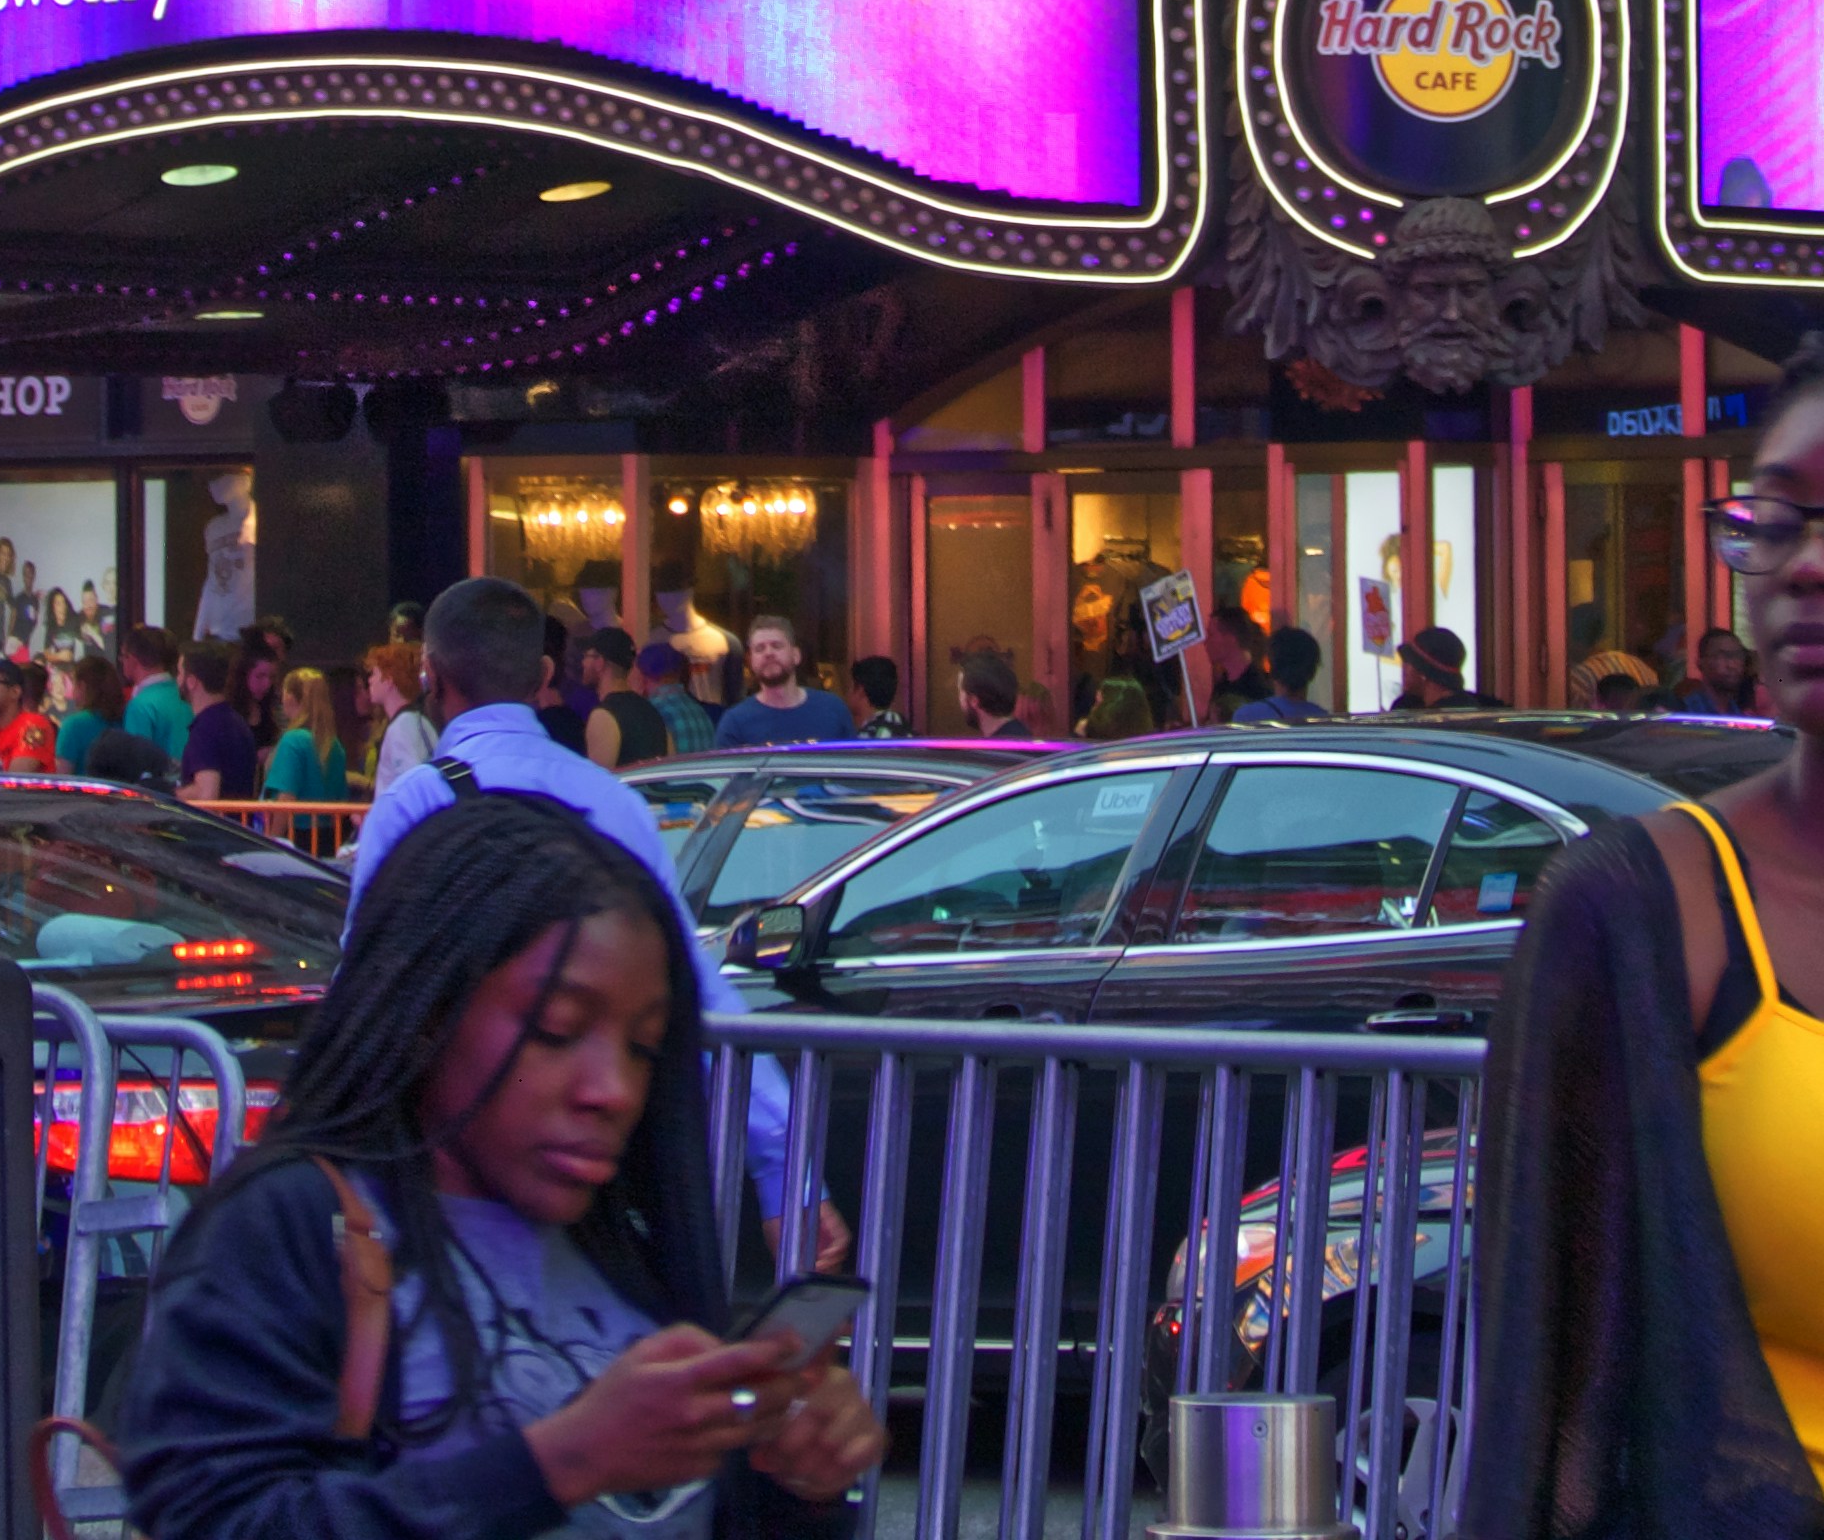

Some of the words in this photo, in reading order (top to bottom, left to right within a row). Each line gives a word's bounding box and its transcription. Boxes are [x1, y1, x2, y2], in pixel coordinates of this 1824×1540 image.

[1450, 0, 1561, 67] Rock
[1415, 72, 1477, 92] CAFE
[1101, 792, 1144, 810] Uber
